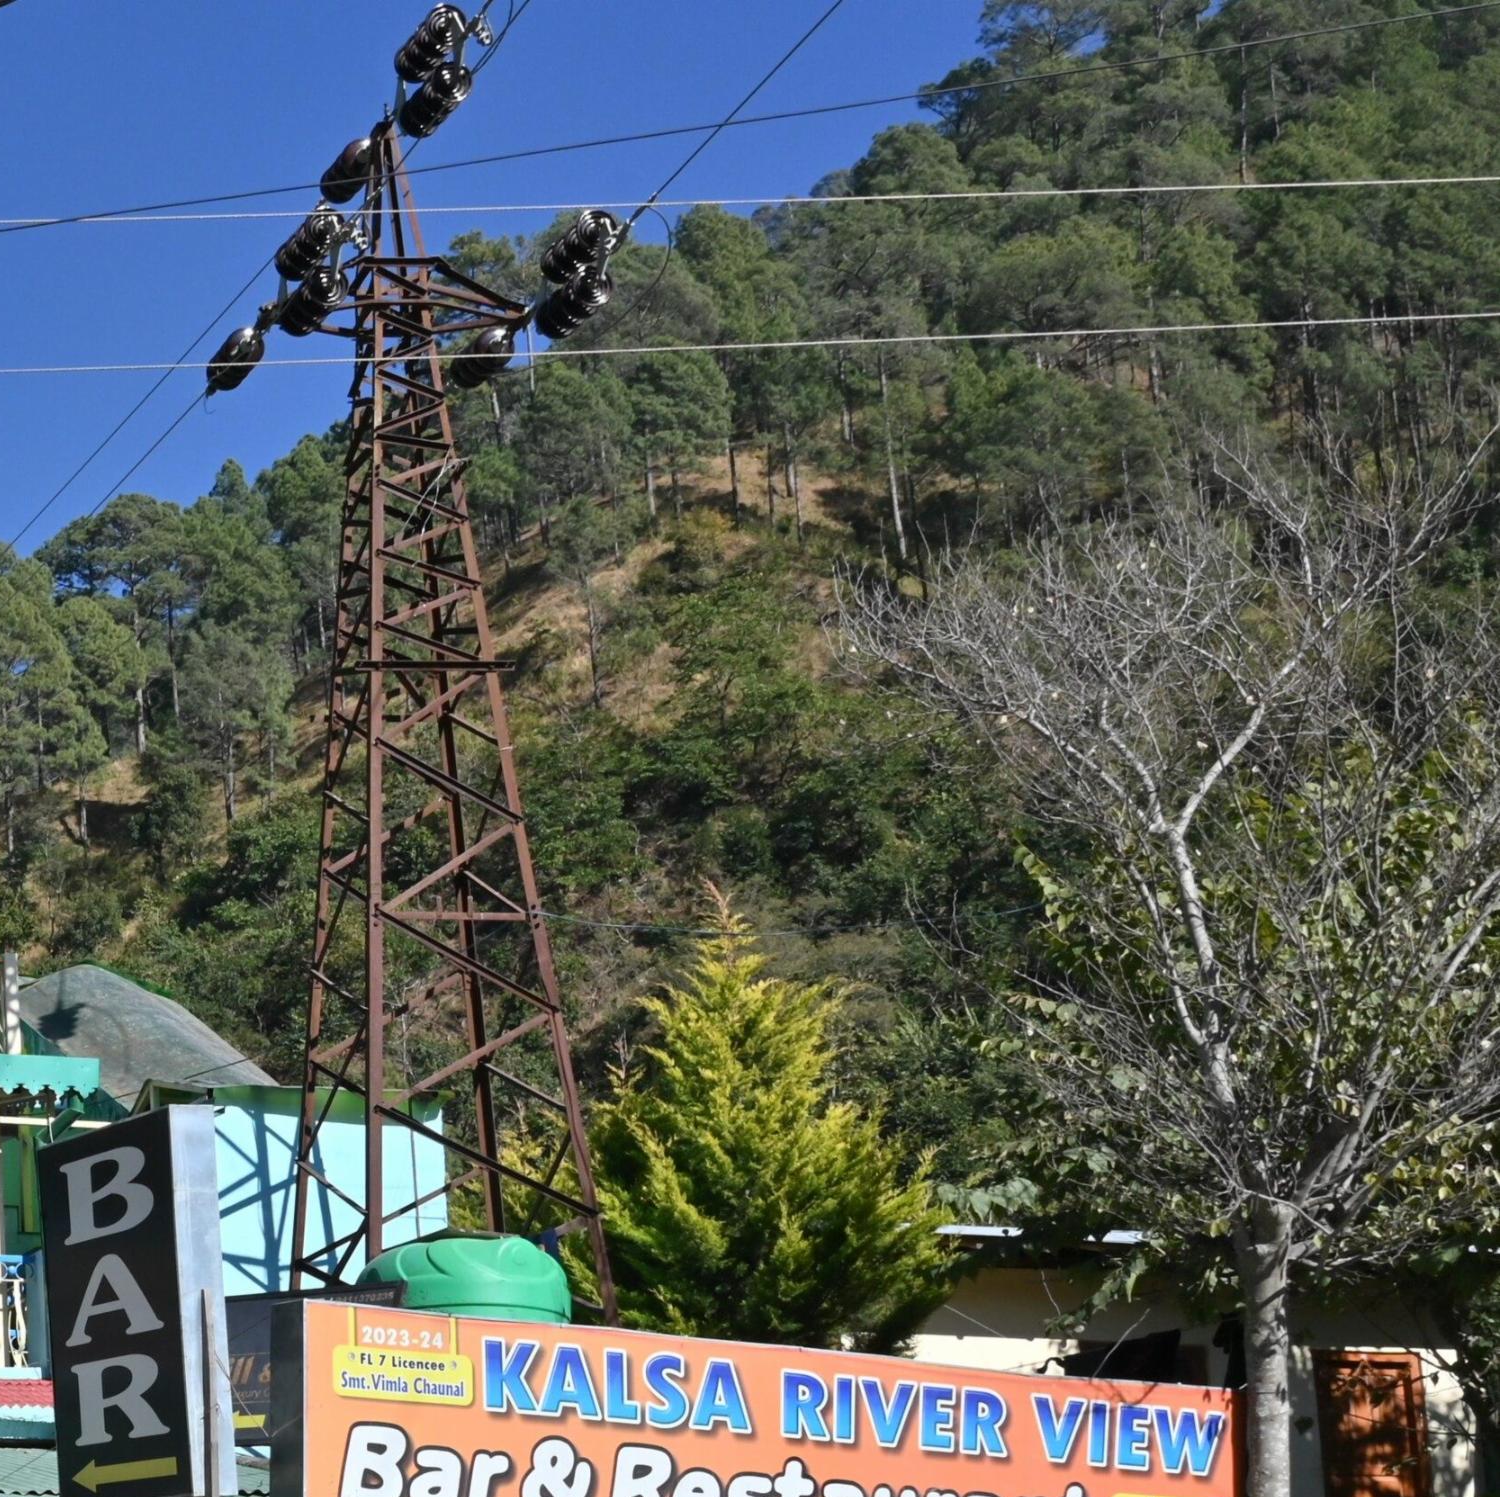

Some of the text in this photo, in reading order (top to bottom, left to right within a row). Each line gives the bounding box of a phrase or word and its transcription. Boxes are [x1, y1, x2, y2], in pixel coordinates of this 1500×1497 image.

[59, 1145, 171, 1447] BAR
[361, 1325, 444, 1349] 2023-24
[360, 1352, 446, 1371] FL 7 Licencee
[413, 1375, 465, 1398] Chaunal
[481, 1335, 1226, 1478] KALSA RIVER VIEW
